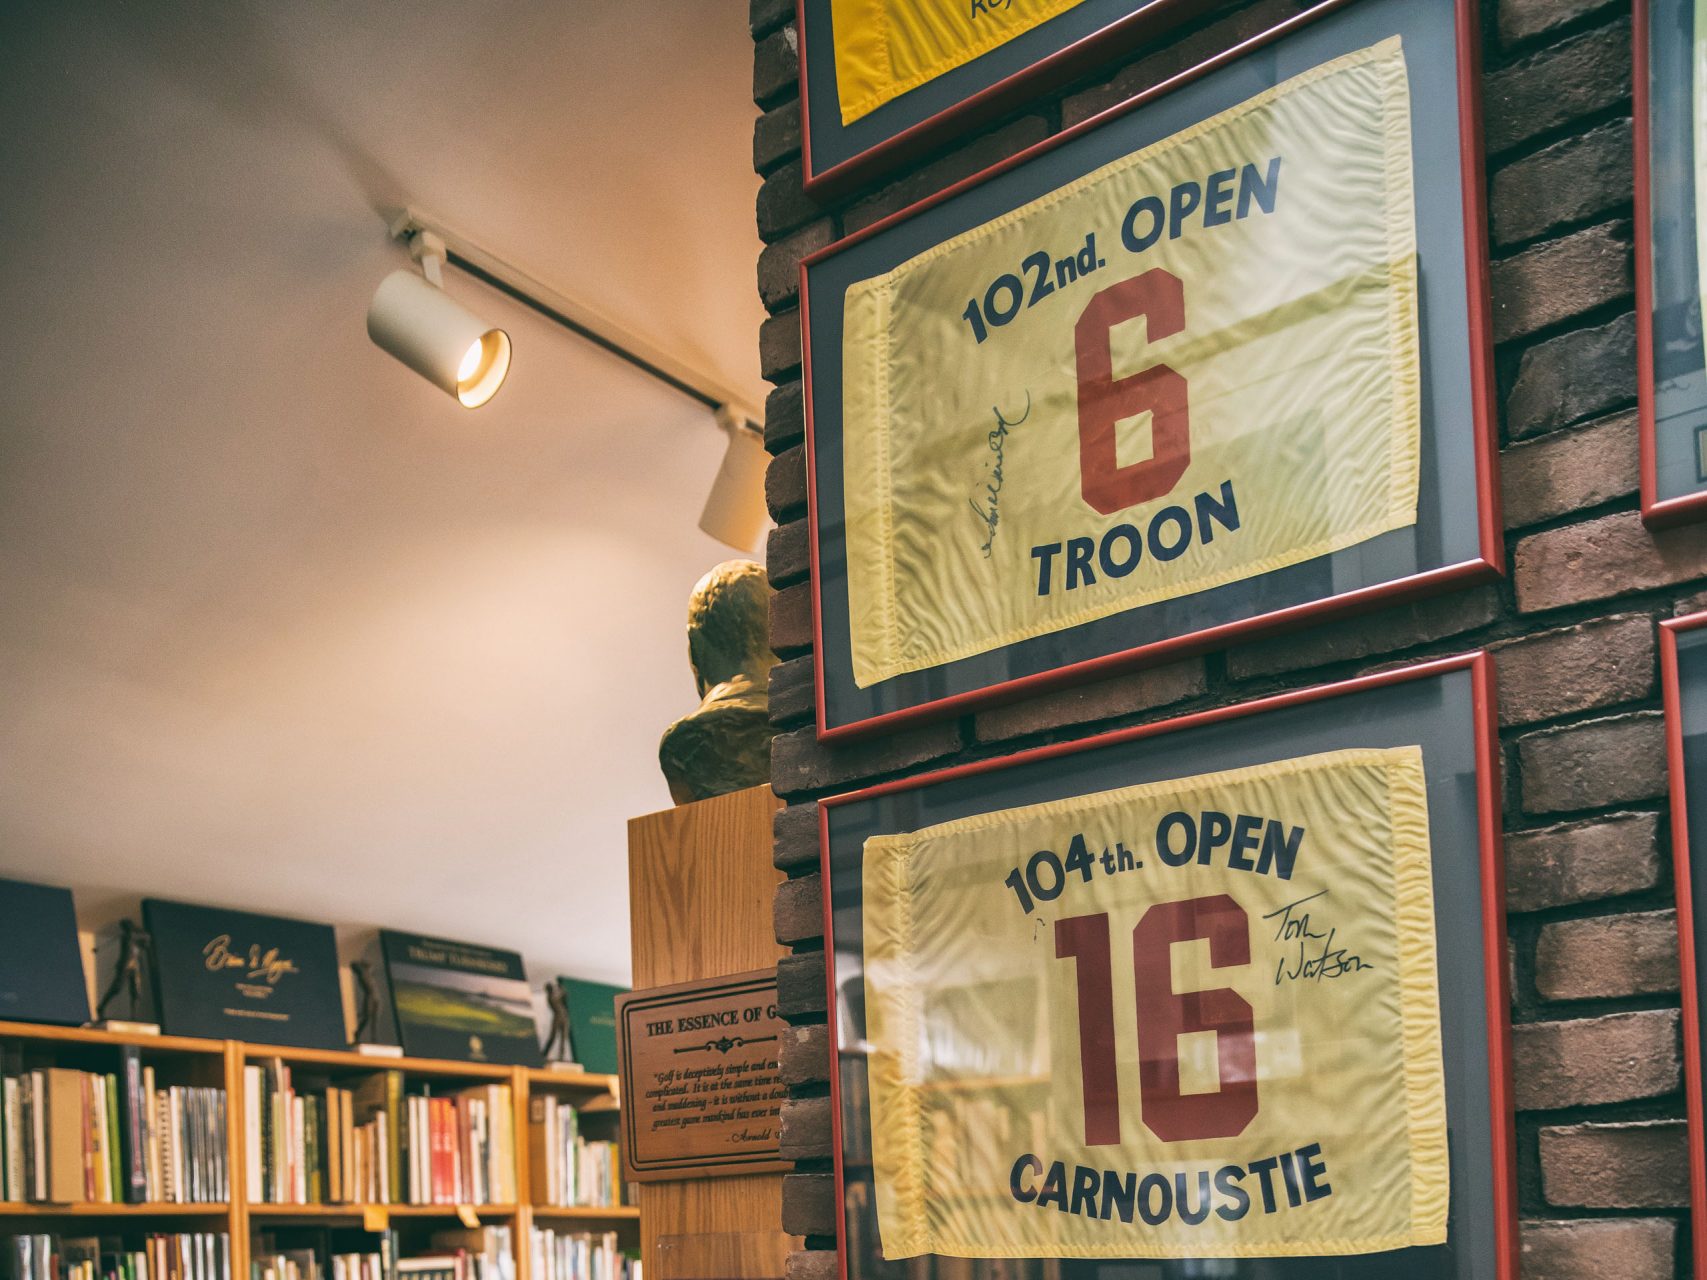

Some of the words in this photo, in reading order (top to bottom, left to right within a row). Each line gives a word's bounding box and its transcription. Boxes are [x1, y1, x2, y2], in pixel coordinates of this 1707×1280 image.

[961, 232, 1107, 345] 102nd.
[1120, 157, 1282, 253] OPEN
[1074, 266, 1191, 516] 6
[1030, 479, 1241, 596] TROON
[1004, 833, 1144, 914] 104th.
[1156, 811, 1305, 881] OPEN
[1262, 889, 1329, 942] Tom
[646, 1020, 674, 1037] THE
[677, 1009, 740, 1033] ESSENCE
[743, 1006, 763, 1023] OF
[751, 1058, 767, 1070] and
[1054, 893, 1259, 1147] 16
[1008, 1141, 1333, 1226] CARNOUSTIE
